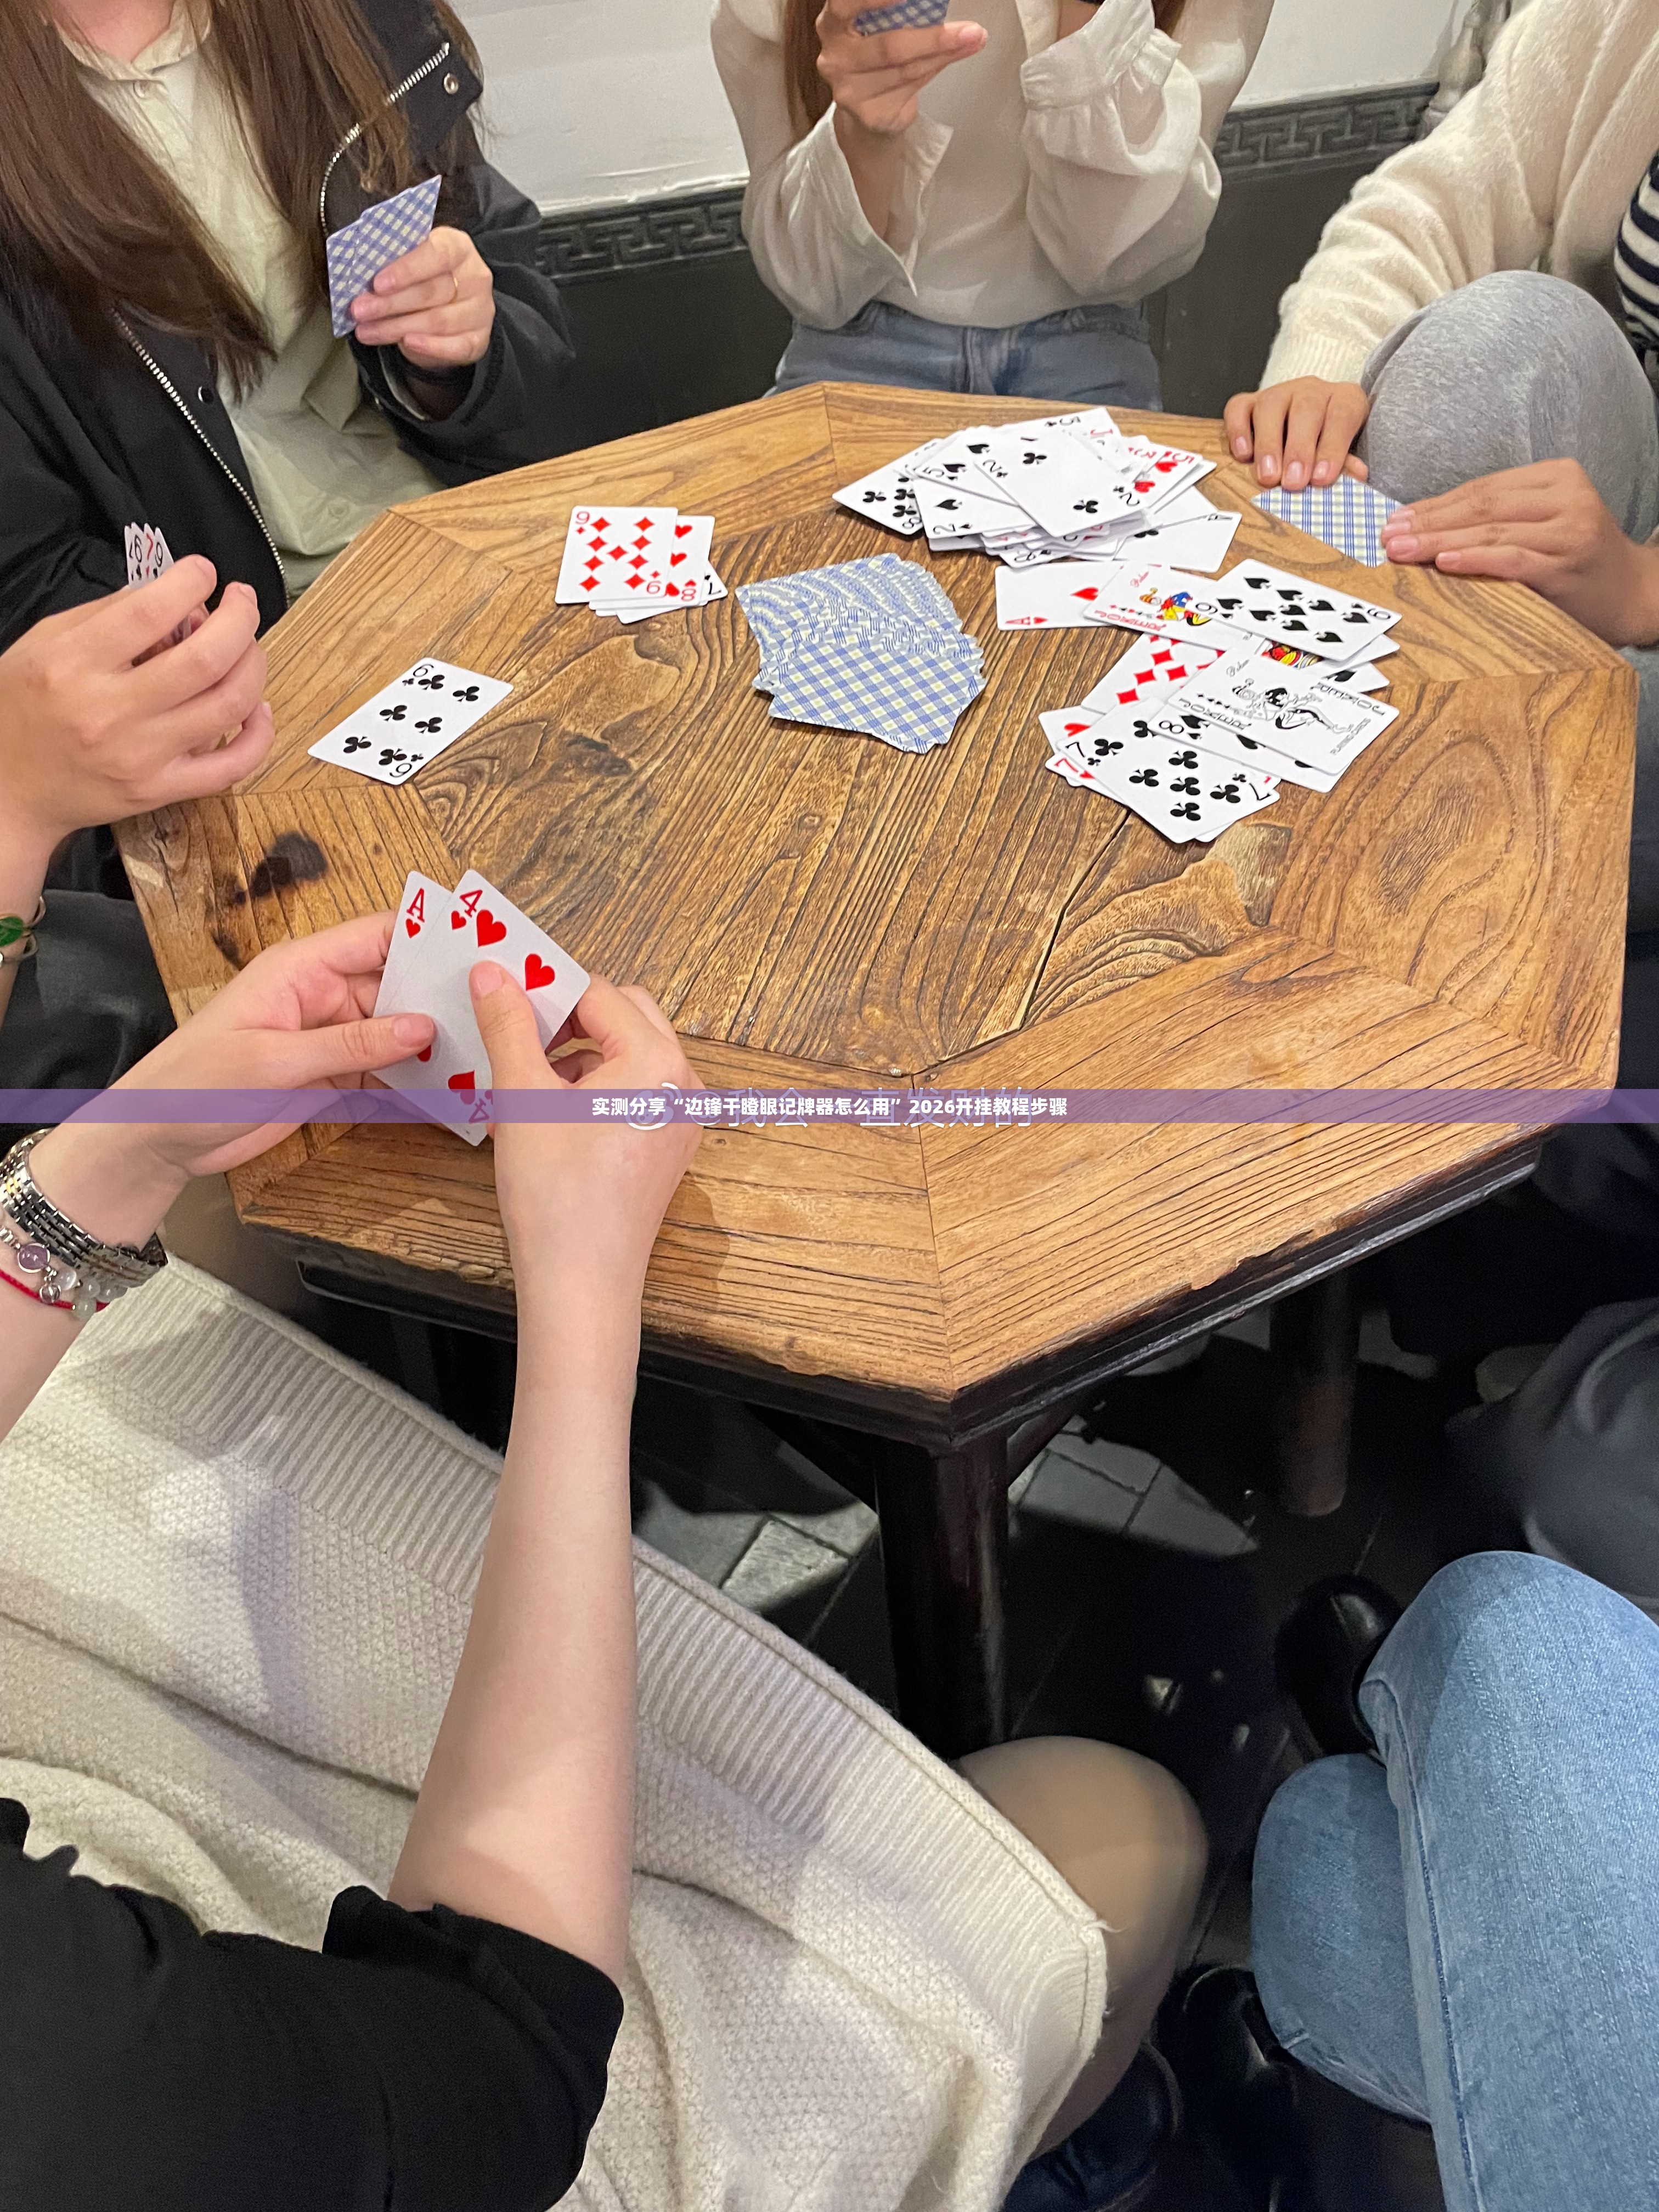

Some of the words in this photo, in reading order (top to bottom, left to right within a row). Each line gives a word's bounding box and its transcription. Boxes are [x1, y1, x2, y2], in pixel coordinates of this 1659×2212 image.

[983, 459, 1002, 473] 2
[1118, 492, 1140, 506] 2
[575, 511, 590, 525] 9
[902, 516, 922, 529] 8
[933, 523, 956, 535] 2
[134, 534, 143, 562] 6
[646, 580, 661, 595] 9
[681, 588, 697, 602] 8
[1094, 610, 1167, 631] JOKER
[413, 664, 435, 678] 6
[1178, 697, 1252, 731] JOKER
[1158, 720, 1184, 734] 8
[1065, 741, 1085, 758] 7
[1054, 758, 1079, 774] 7
[1249, 782, 1272, 801] 7
[406, 887, 425, 923] A
[459, 889, 483, 918] 4
[468, 1098, 490, 1124] 4
